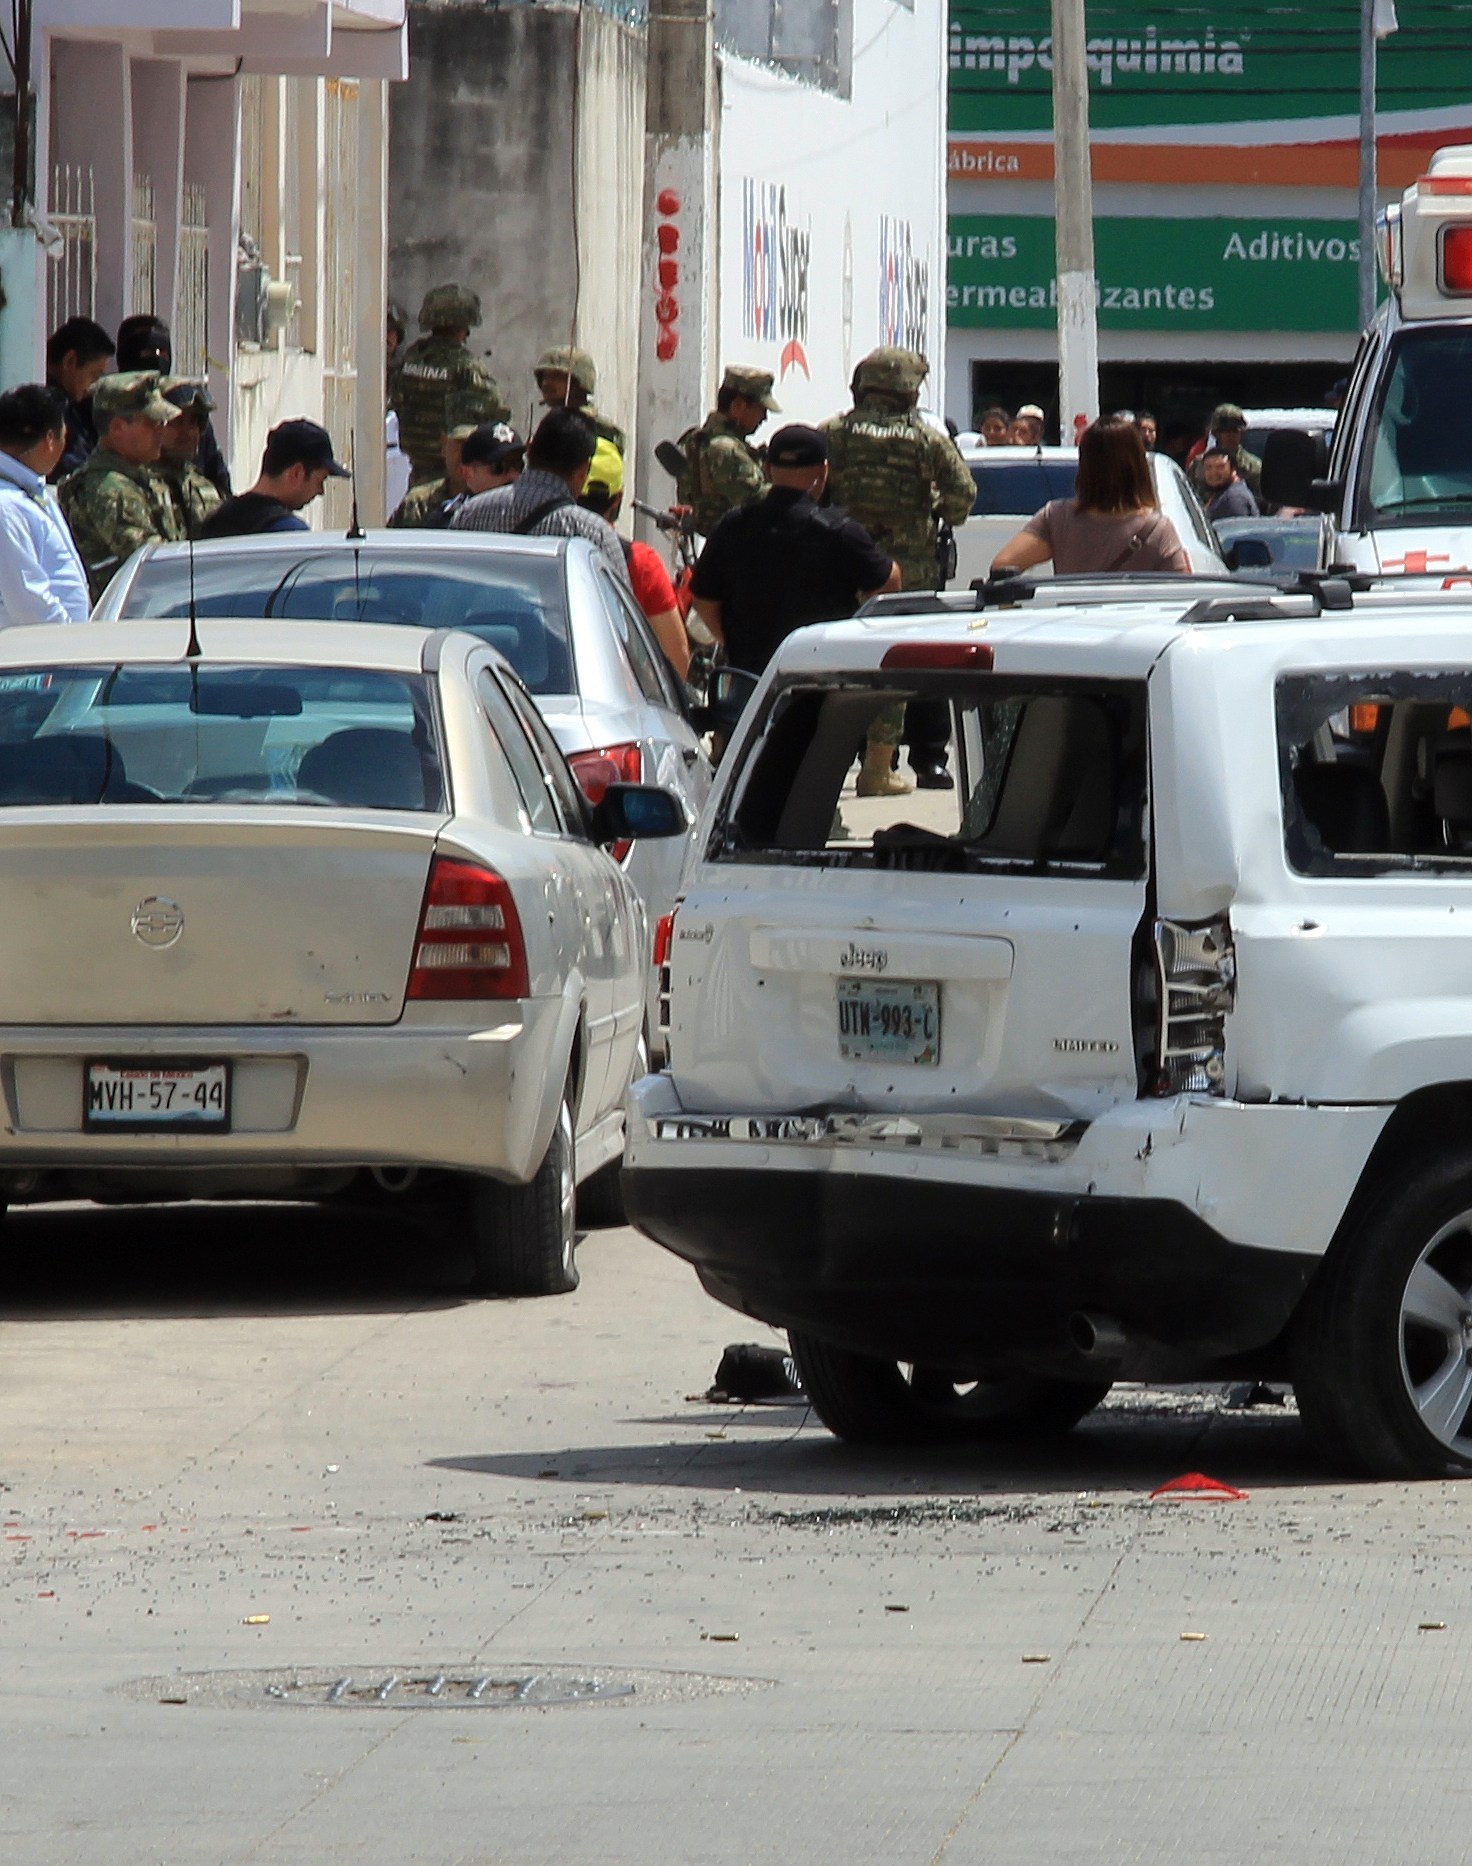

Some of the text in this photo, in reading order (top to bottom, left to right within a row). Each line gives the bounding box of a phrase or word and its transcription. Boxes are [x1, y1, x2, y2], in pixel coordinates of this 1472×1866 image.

[948, 150, 1019, 172] ábrica
[946, 234, 1017, 259] uras
[1222, 231, 1361, 262] Aditivos
[851, 421, 916, 441] MARINA
[839, 942, 888, 973] Jeep
[1051, 1038, 1120, 1053] LIMITED
[90, 1079, 223, 1111] MVH-57-44
